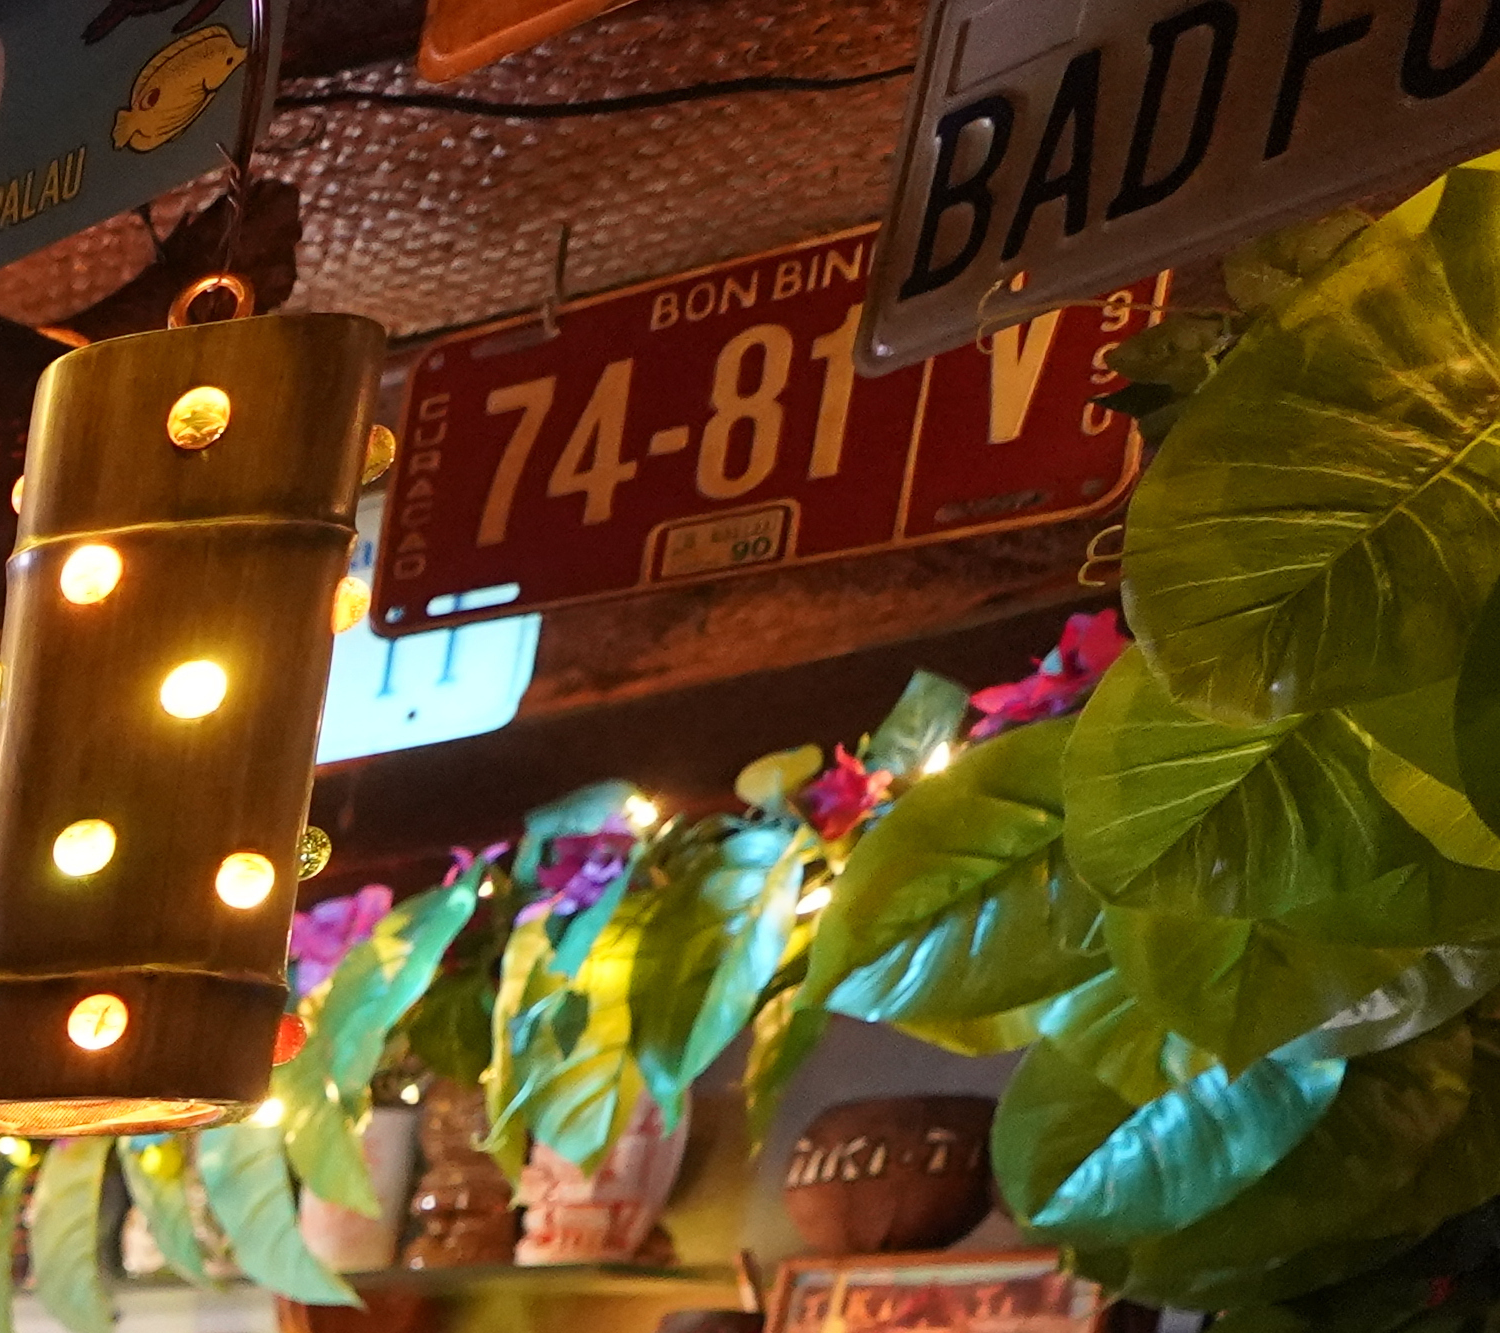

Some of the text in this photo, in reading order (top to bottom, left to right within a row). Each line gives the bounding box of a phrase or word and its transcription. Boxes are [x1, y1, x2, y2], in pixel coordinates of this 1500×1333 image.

[901, 4, 1238, 300] BAD
[649, 269, 760, 331] BON
[476, 304, 867, 548] 74-81
